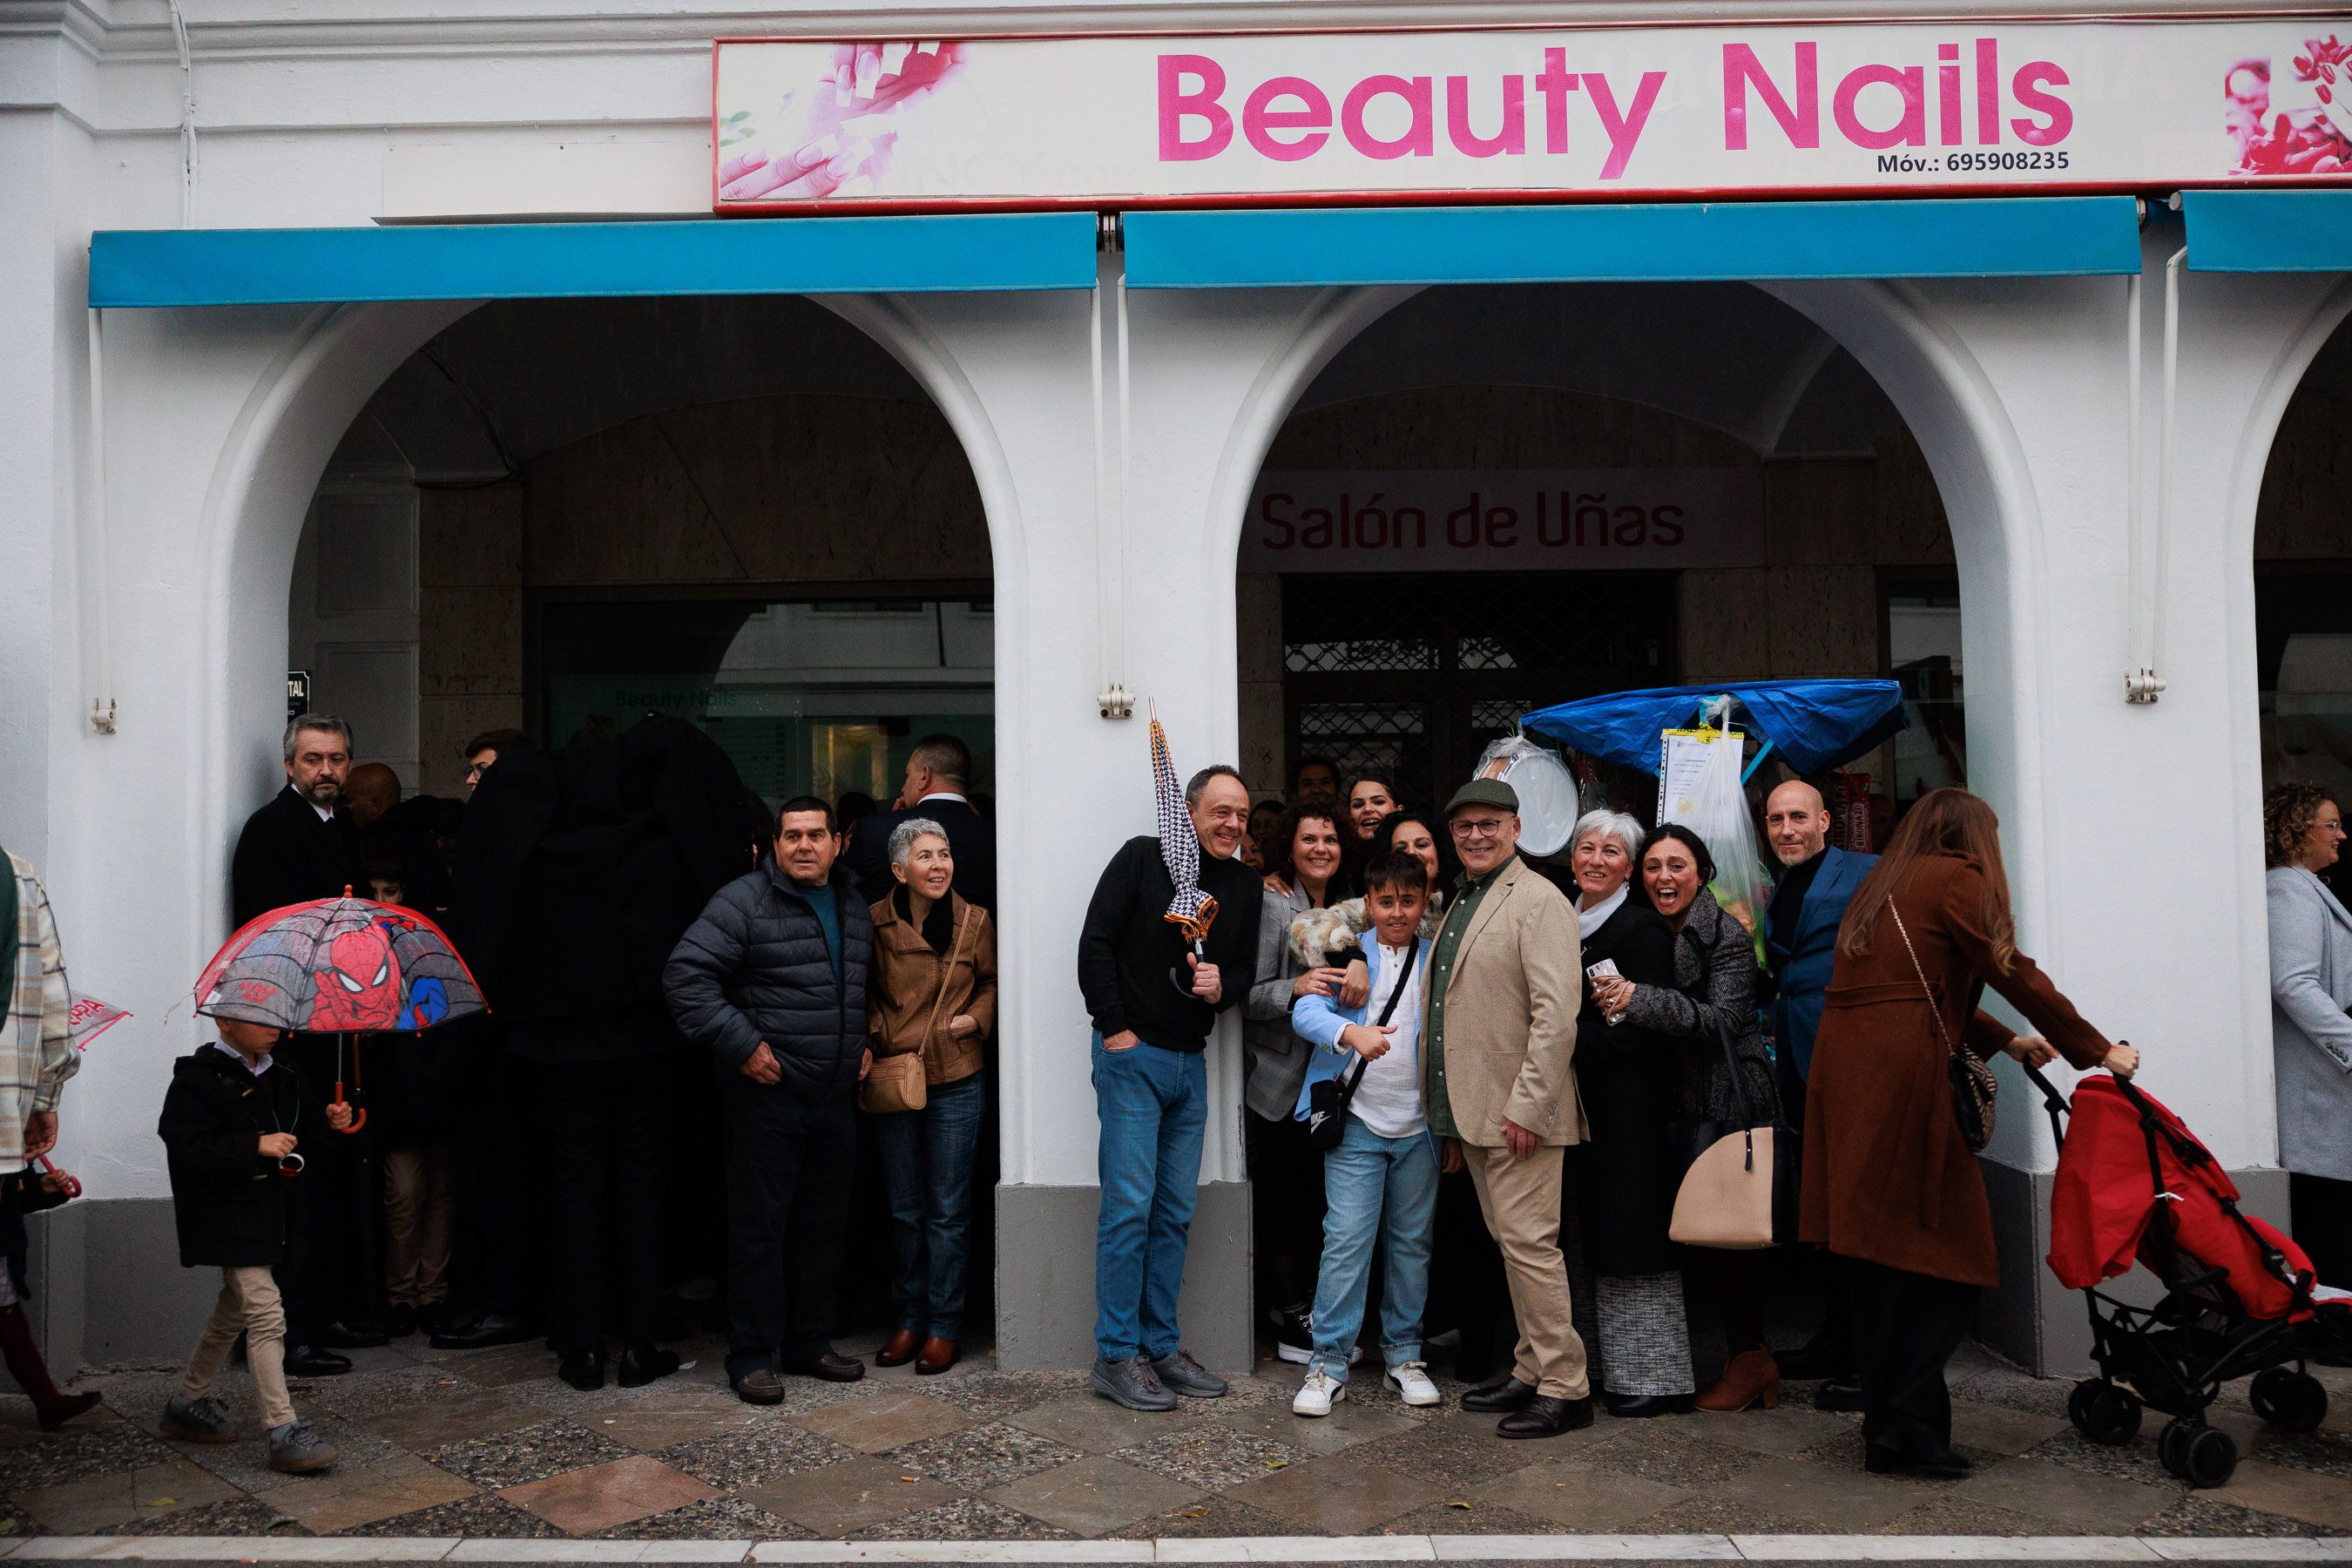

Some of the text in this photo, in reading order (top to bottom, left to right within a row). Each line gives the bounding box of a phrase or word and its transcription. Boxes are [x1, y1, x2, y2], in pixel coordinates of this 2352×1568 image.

[1158, 38, 2072, 179] Beauty Nails
[1878, 152, 2069, 172] Móv.: 695908235
[1261, 490, 1686, 550] Salón de Uñas
[616, 691, 737, 710] Beauty Nails
[1854, 804, 1865, 847] KIKONAZO
